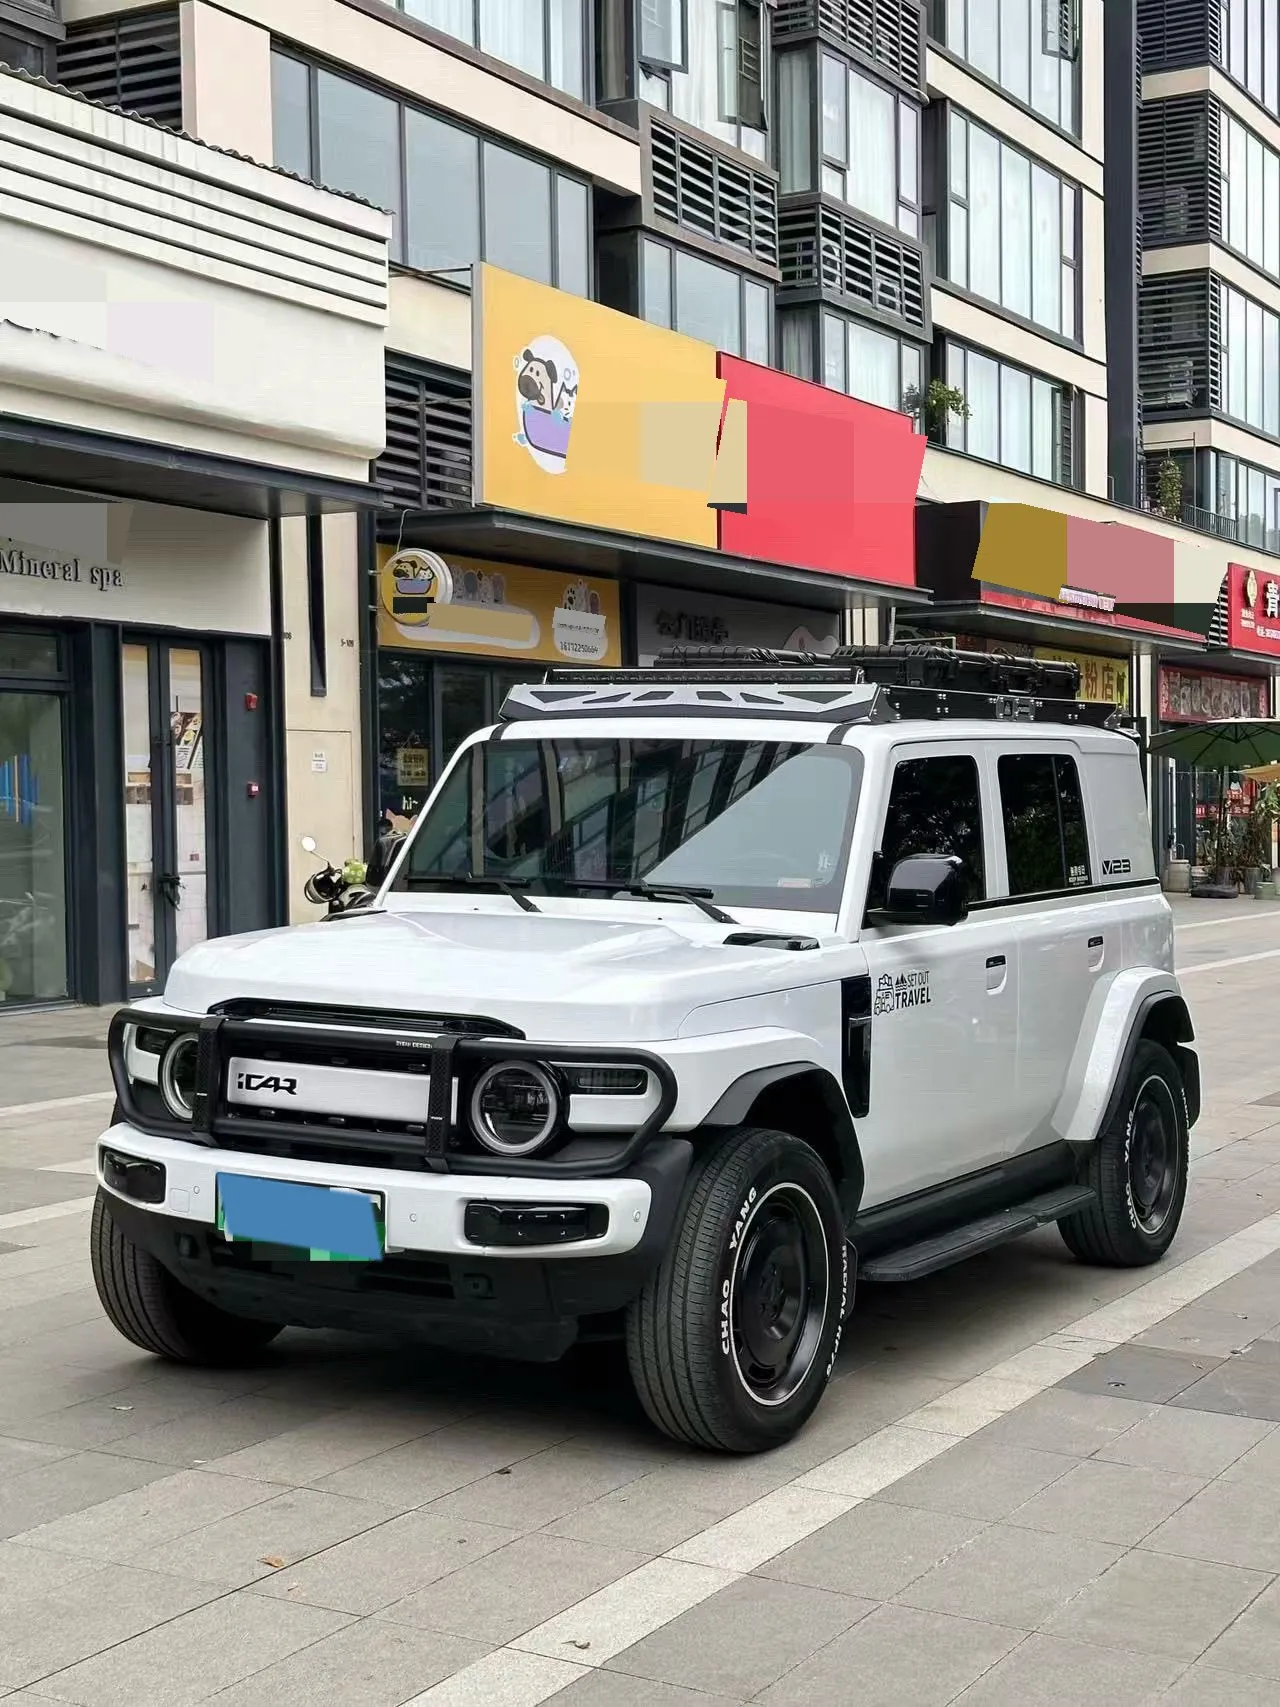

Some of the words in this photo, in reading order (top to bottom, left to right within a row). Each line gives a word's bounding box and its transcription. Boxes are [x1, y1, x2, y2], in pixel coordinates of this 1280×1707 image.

[0, 547, 82, 582] Mineral
[90, 566, 126, 592] spa
[1080, 660, 1114, 701] 粉店
[895, 986, 931, 1009] TRAVEL
[907, 973, 918, 988] SET
[918, 970, 930, 986] OUT
[1124, 1109, 1134, 1163] YANG
[721, 1278, 731, 1355] CHAO
[729, 1186, 757, 1250] YANG
[839, 1244, 848, 1320] RADIAL
